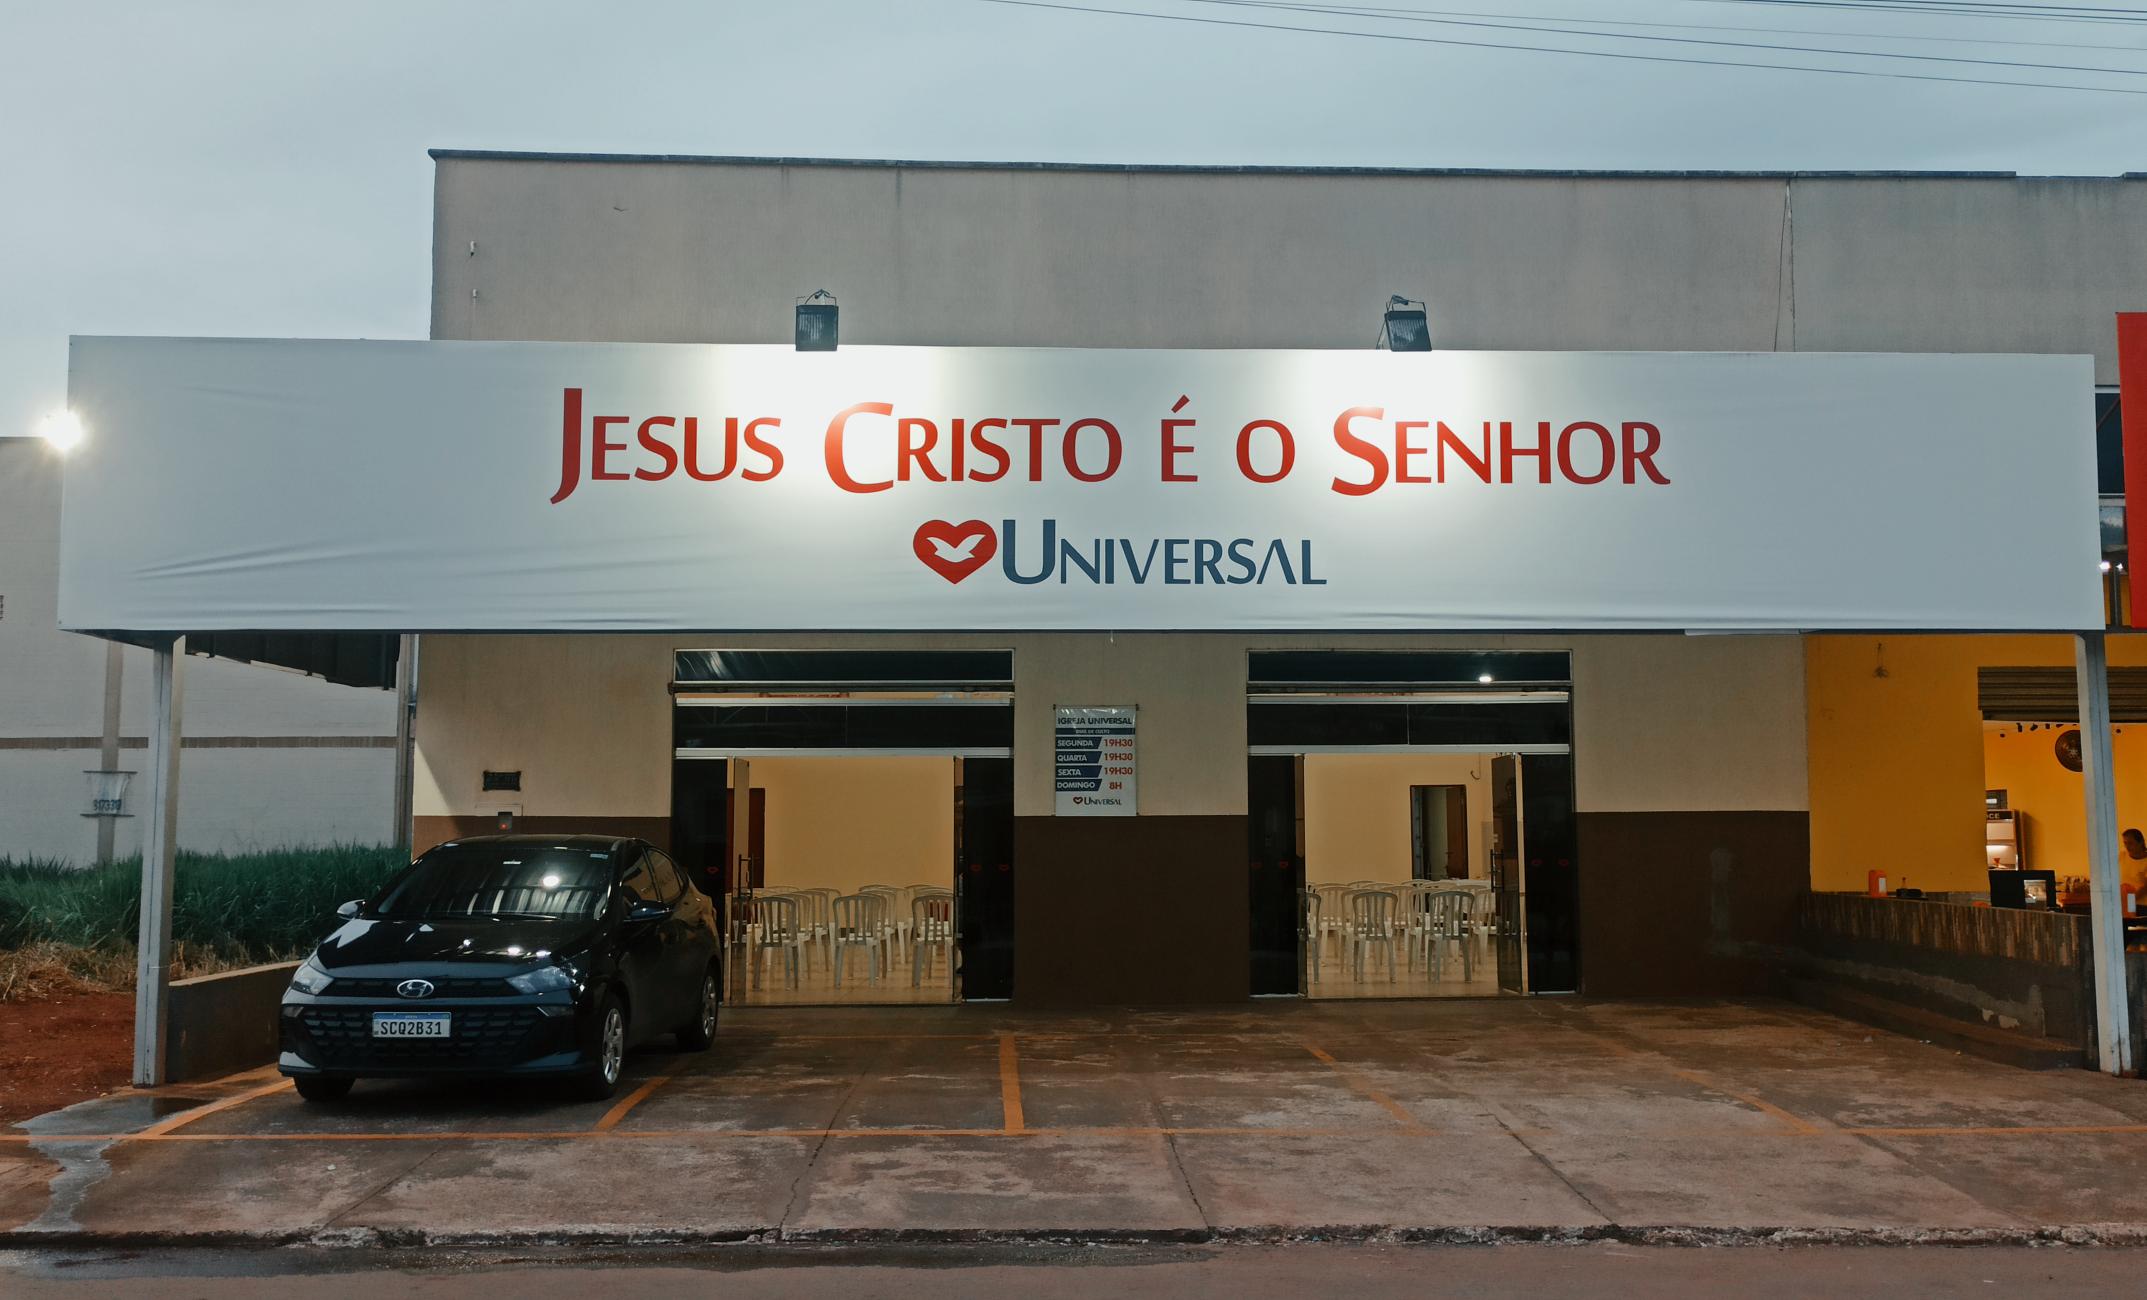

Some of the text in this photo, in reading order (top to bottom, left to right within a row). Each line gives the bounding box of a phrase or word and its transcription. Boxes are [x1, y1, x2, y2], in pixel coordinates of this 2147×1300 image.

[550, 388, 1671, 504] JESUS CRISTO É O SENHOR
[1003, 519, 1327, 584] UNIVERSAL
[1104, 739, 1133, 747] 19H30
[1057, 753, 1133, 762] QUARTA 19H30
[1104, 767, 1133, 775] 19H30
[1109, 782, 1122, 790] 8H
[1084, 797, 1122, 806] UNIVERSAL
[381, 1021, 442, 1035] SCQ2B31
